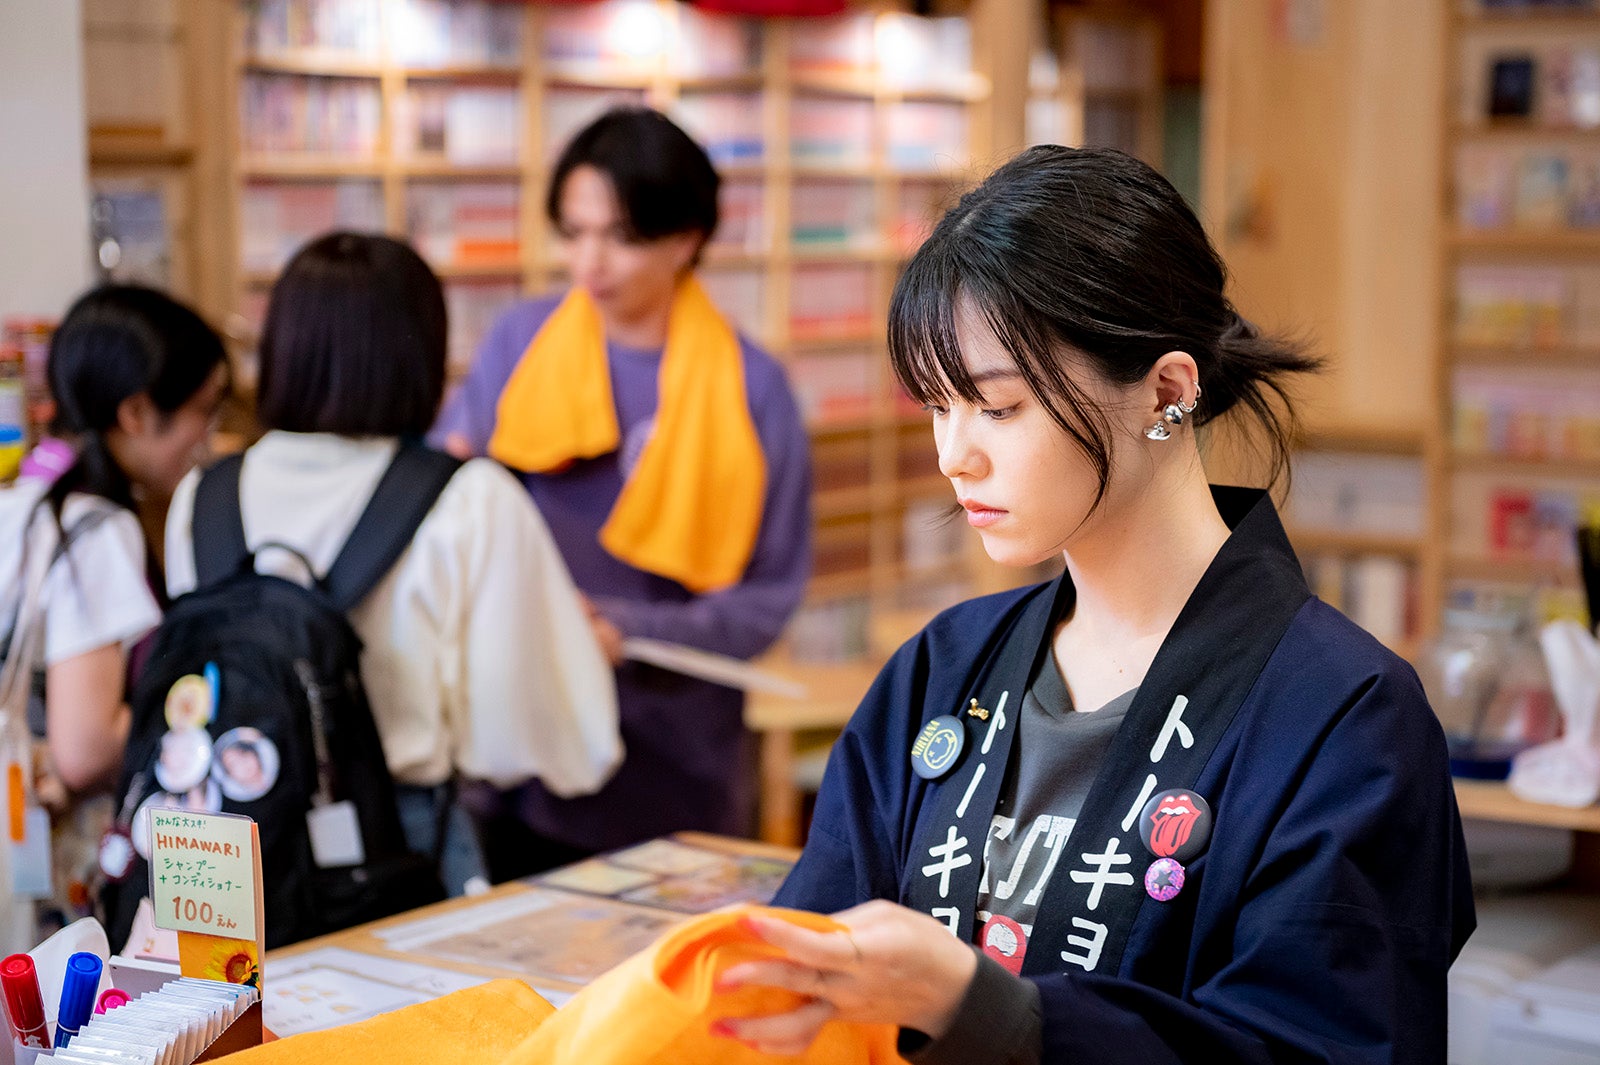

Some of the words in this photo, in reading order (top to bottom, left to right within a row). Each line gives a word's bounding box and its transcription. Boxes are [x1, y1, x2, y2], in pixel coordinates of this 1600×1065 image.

[911, 720, 940, 759] NIRVANA
[156, 832, 241, 858] HIMAWARI
[163, 857, 216, 871] シャンプー
[172, 871, 242, 891] コンディショナー
[172, 896, 213, 924] 100
[216, 914, 237, 929] えん
